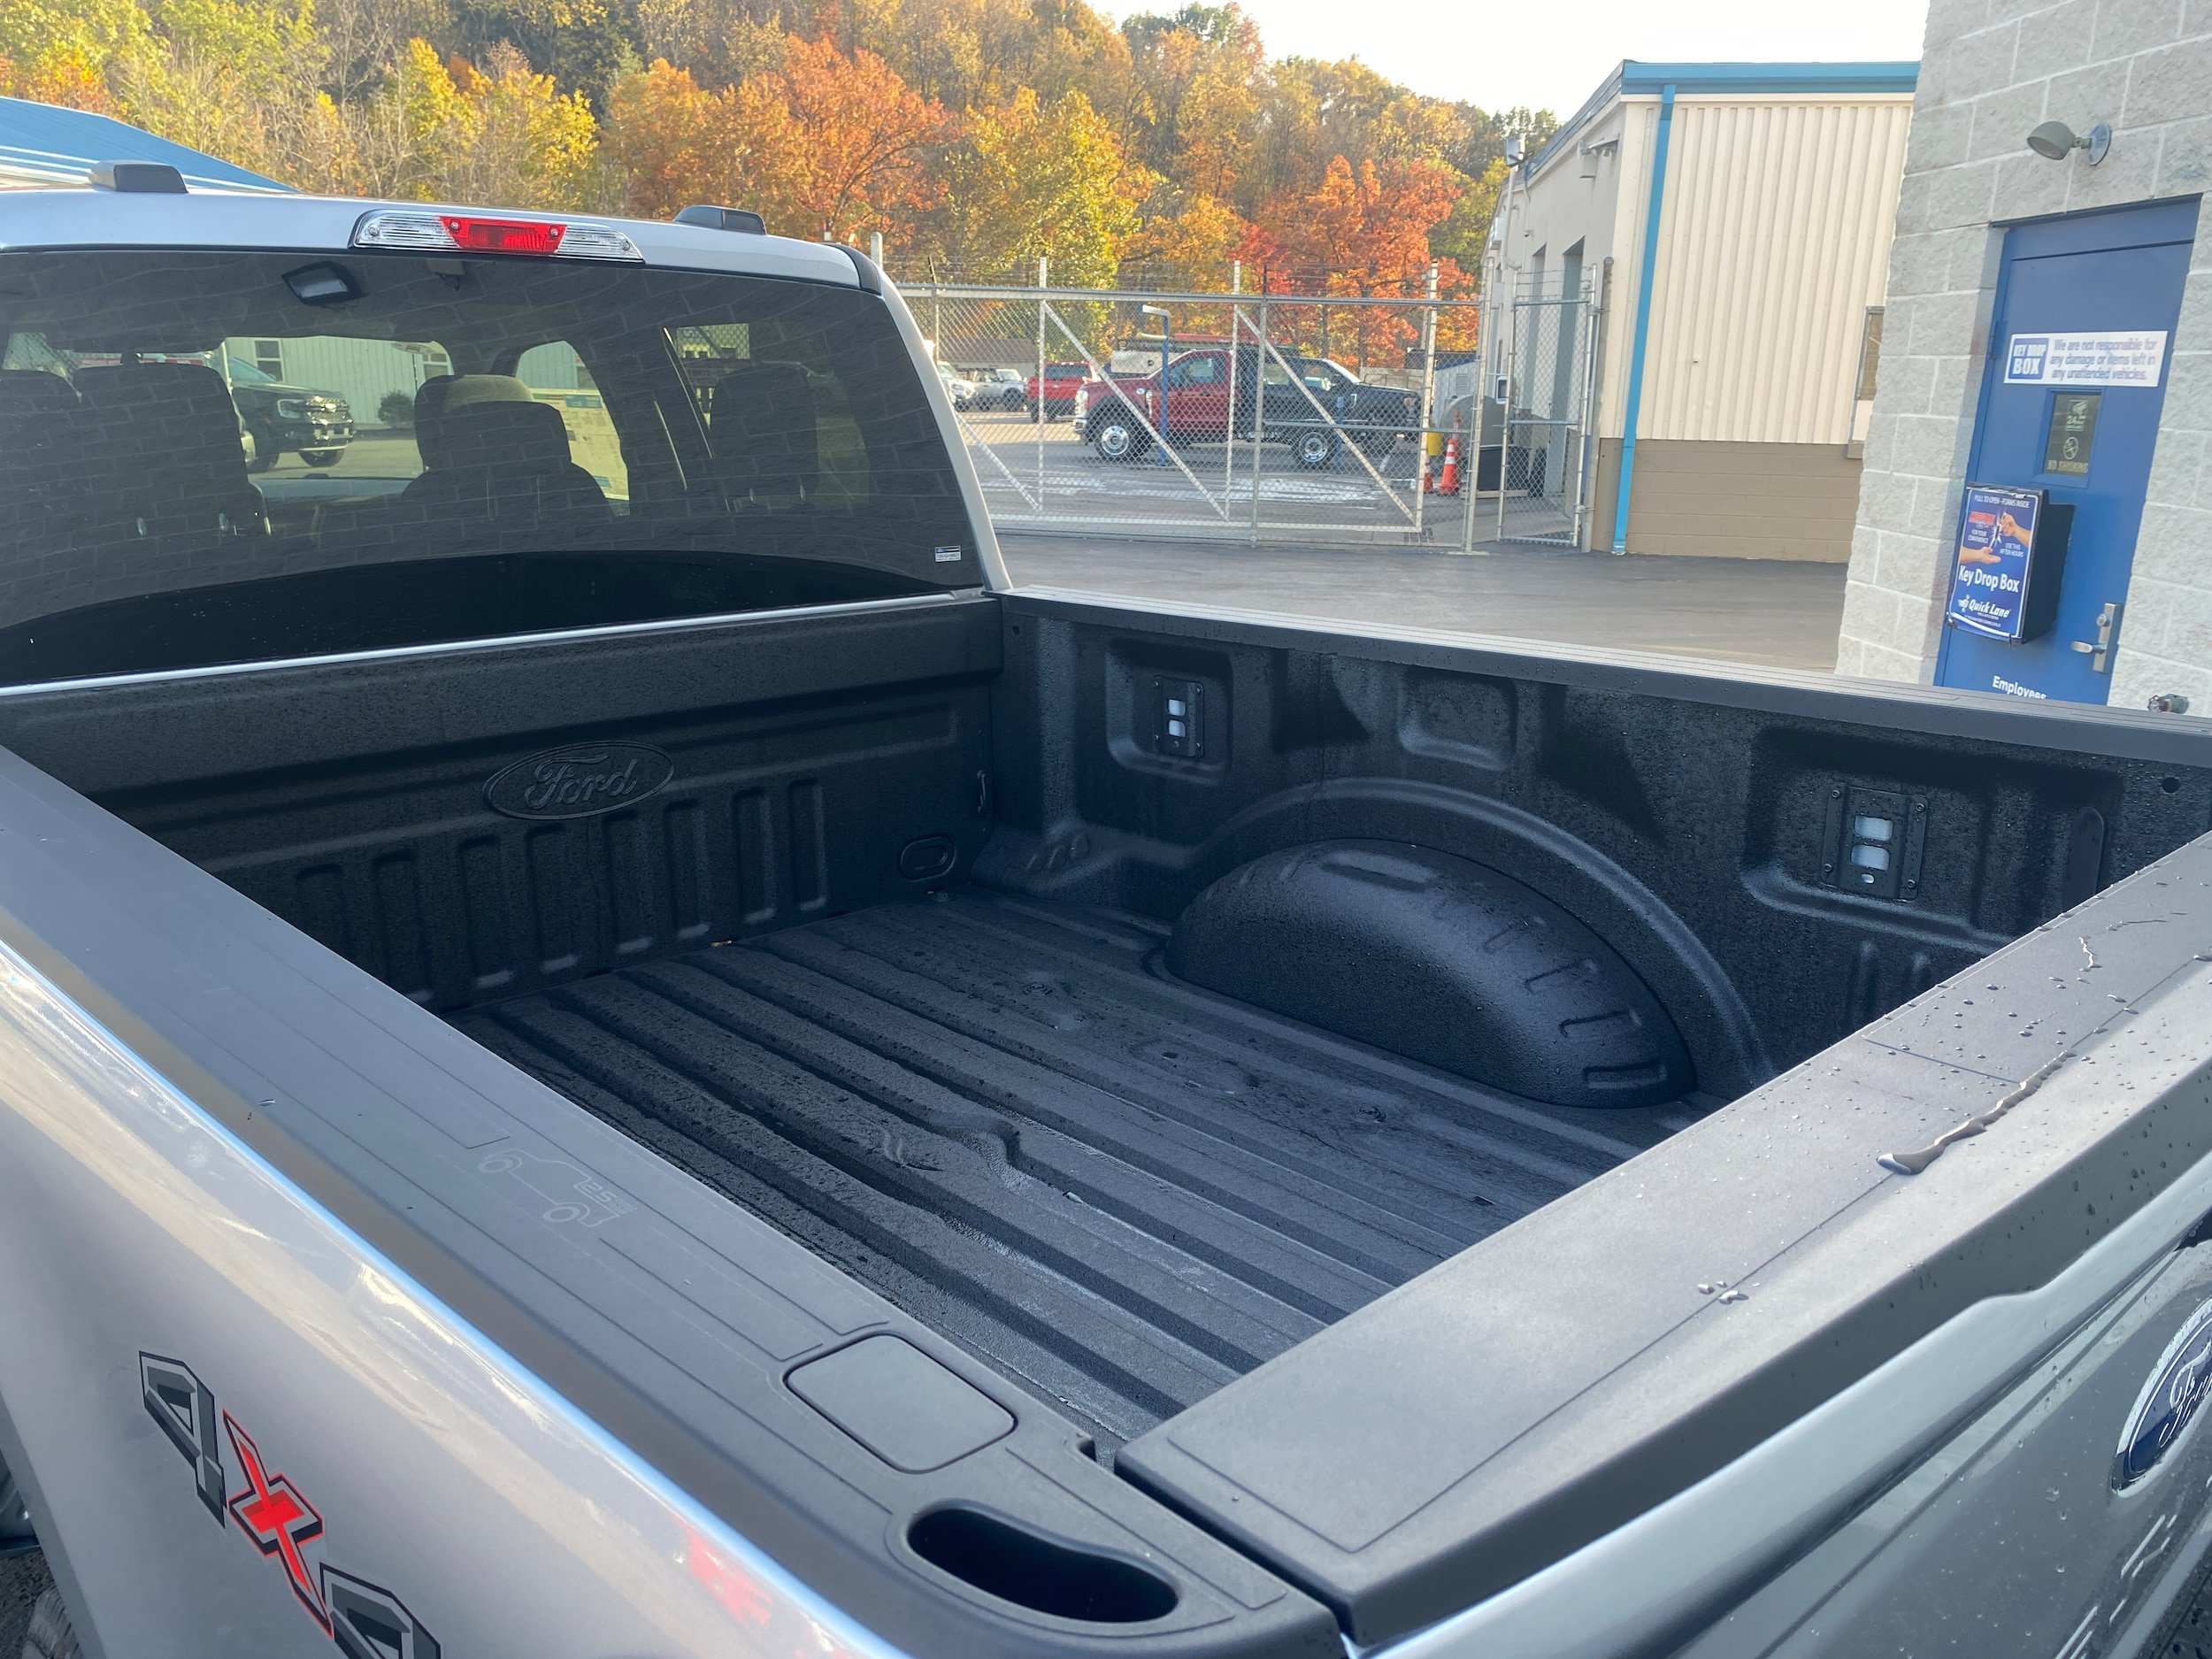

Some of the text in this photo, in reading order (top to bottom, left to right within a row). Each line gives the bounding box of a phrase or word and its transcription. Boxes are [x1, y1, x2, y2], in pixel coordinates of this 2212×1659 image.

[2055, 337, 2158, 350] We are not responsible for
[2012, 357, 2041, 375] BOX
[2050, 353, 2156, 368] any damage or items left in
[2052, 369, 2066, 381] any
[2067, 367, 2110, 380] unattended
[2001, 497, 2016, 507] FORMS
[2016, 499, 2031, 509] INSIDE
[2010, 549, 2024, 558] HOURS
[1958, 565, 2021, 593] Key Drop Box
[1969, 598, 1990, 614] Quick
[1989, 603, 2010, 618] Lane
[1992, 675, 2047, 699] Employees
[524, 752, 638, 809] Ford
